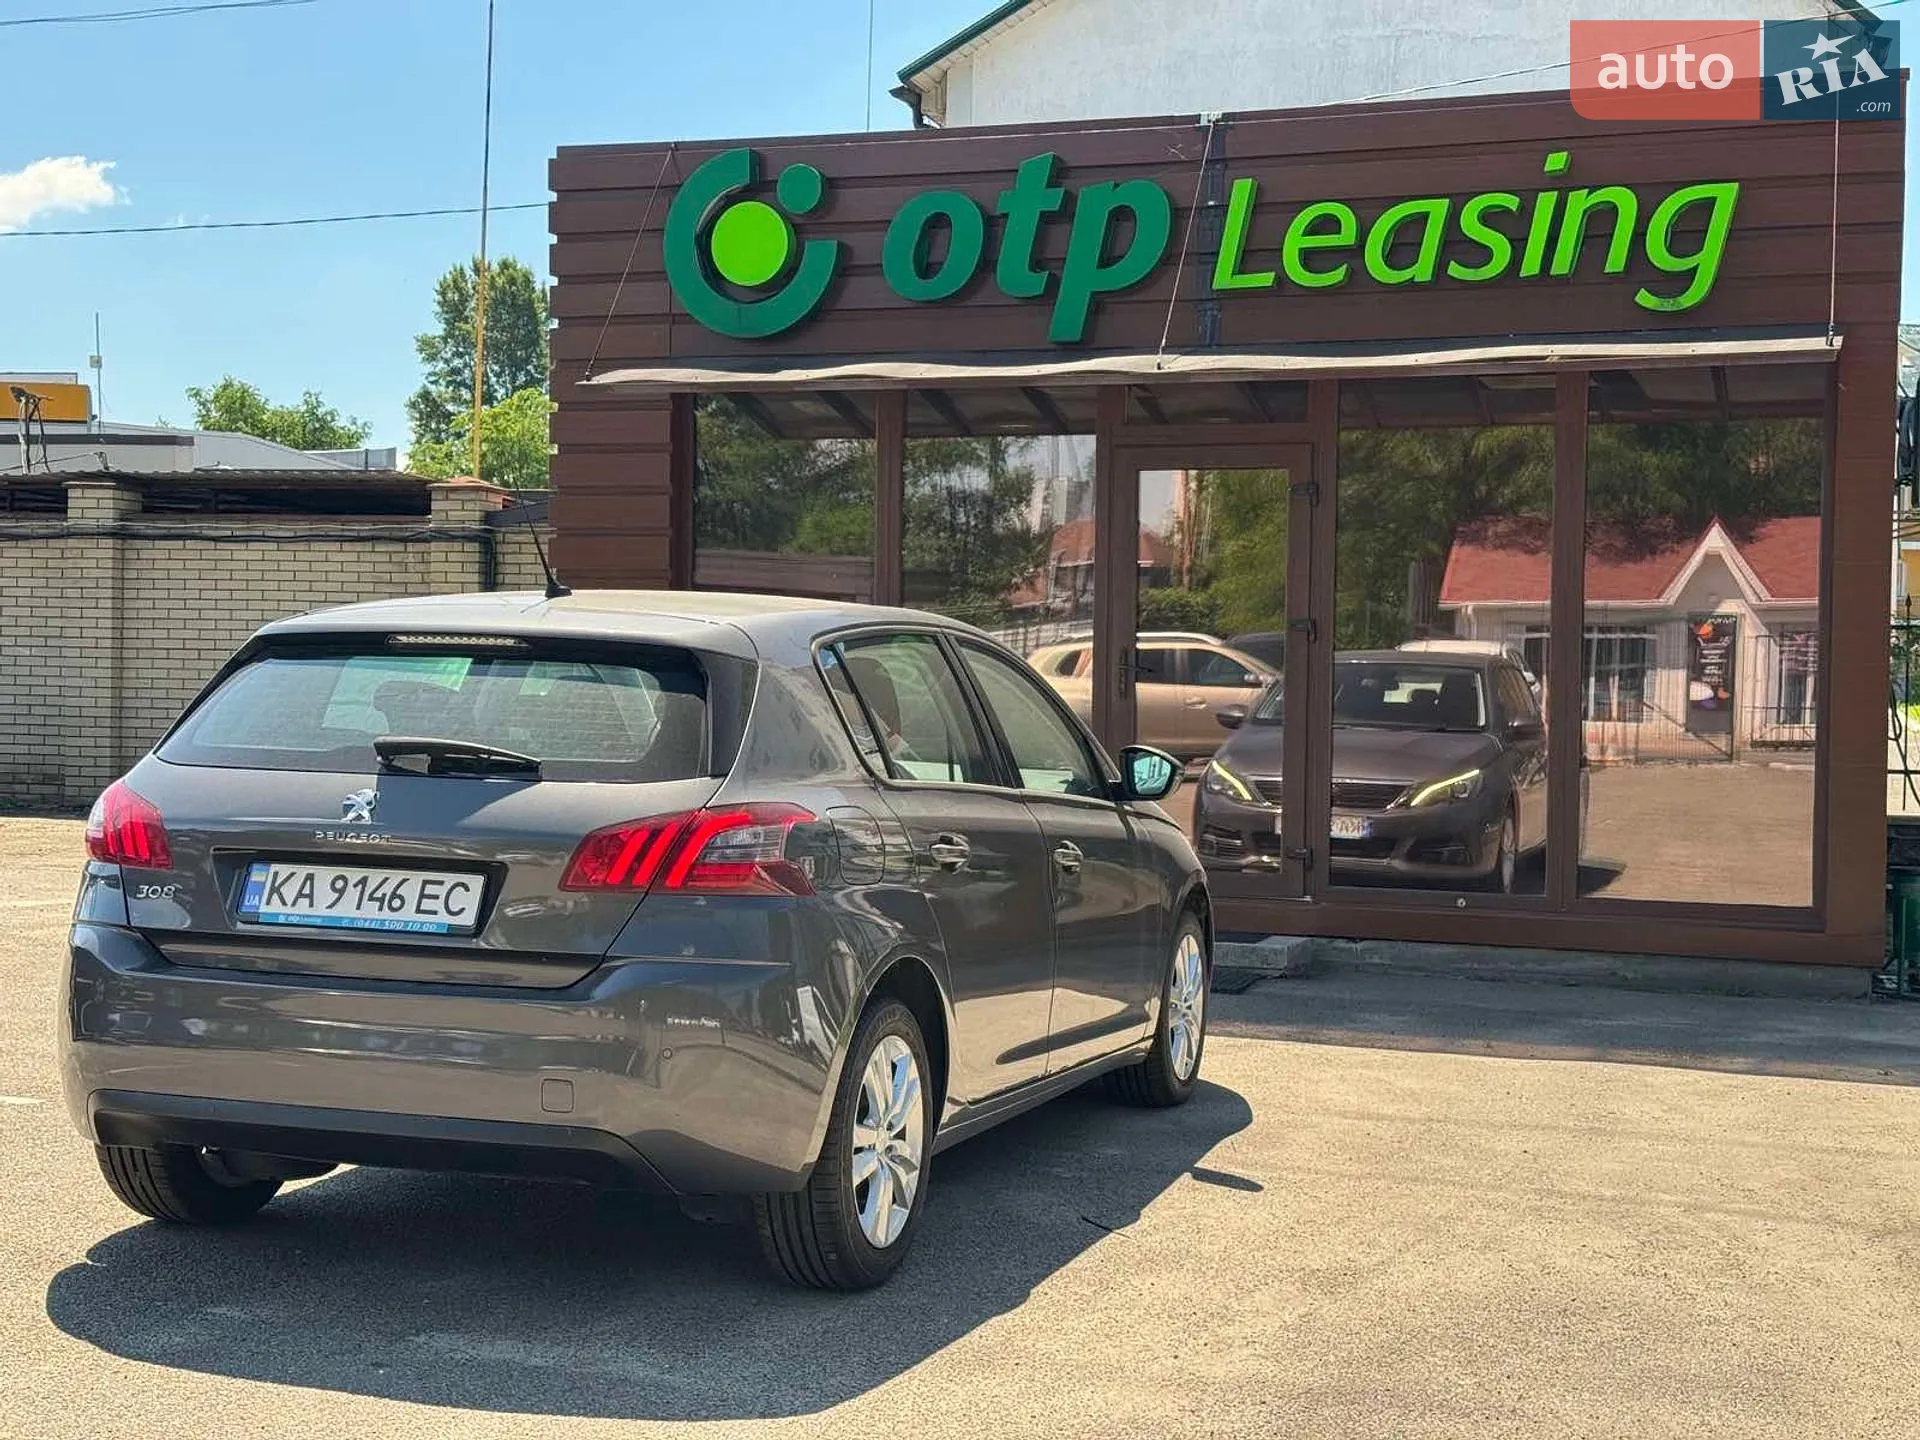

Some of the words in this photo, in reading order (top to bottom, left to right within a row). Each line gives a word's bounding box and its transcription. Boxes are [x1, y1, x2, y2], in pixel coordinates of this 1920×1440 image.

[882, 151, 1171, 343] otp
[1212, 150, 1741, 312] Leasing
[315, 831, 392, 844] PEUGEOT
[136, 885, 176, 899] 308
[265, 870, 315, 908] KA
[325, 873, 410, 914] 9146
[415, 879, 471, 917] EC
[244, 897, 260, 906] UA
